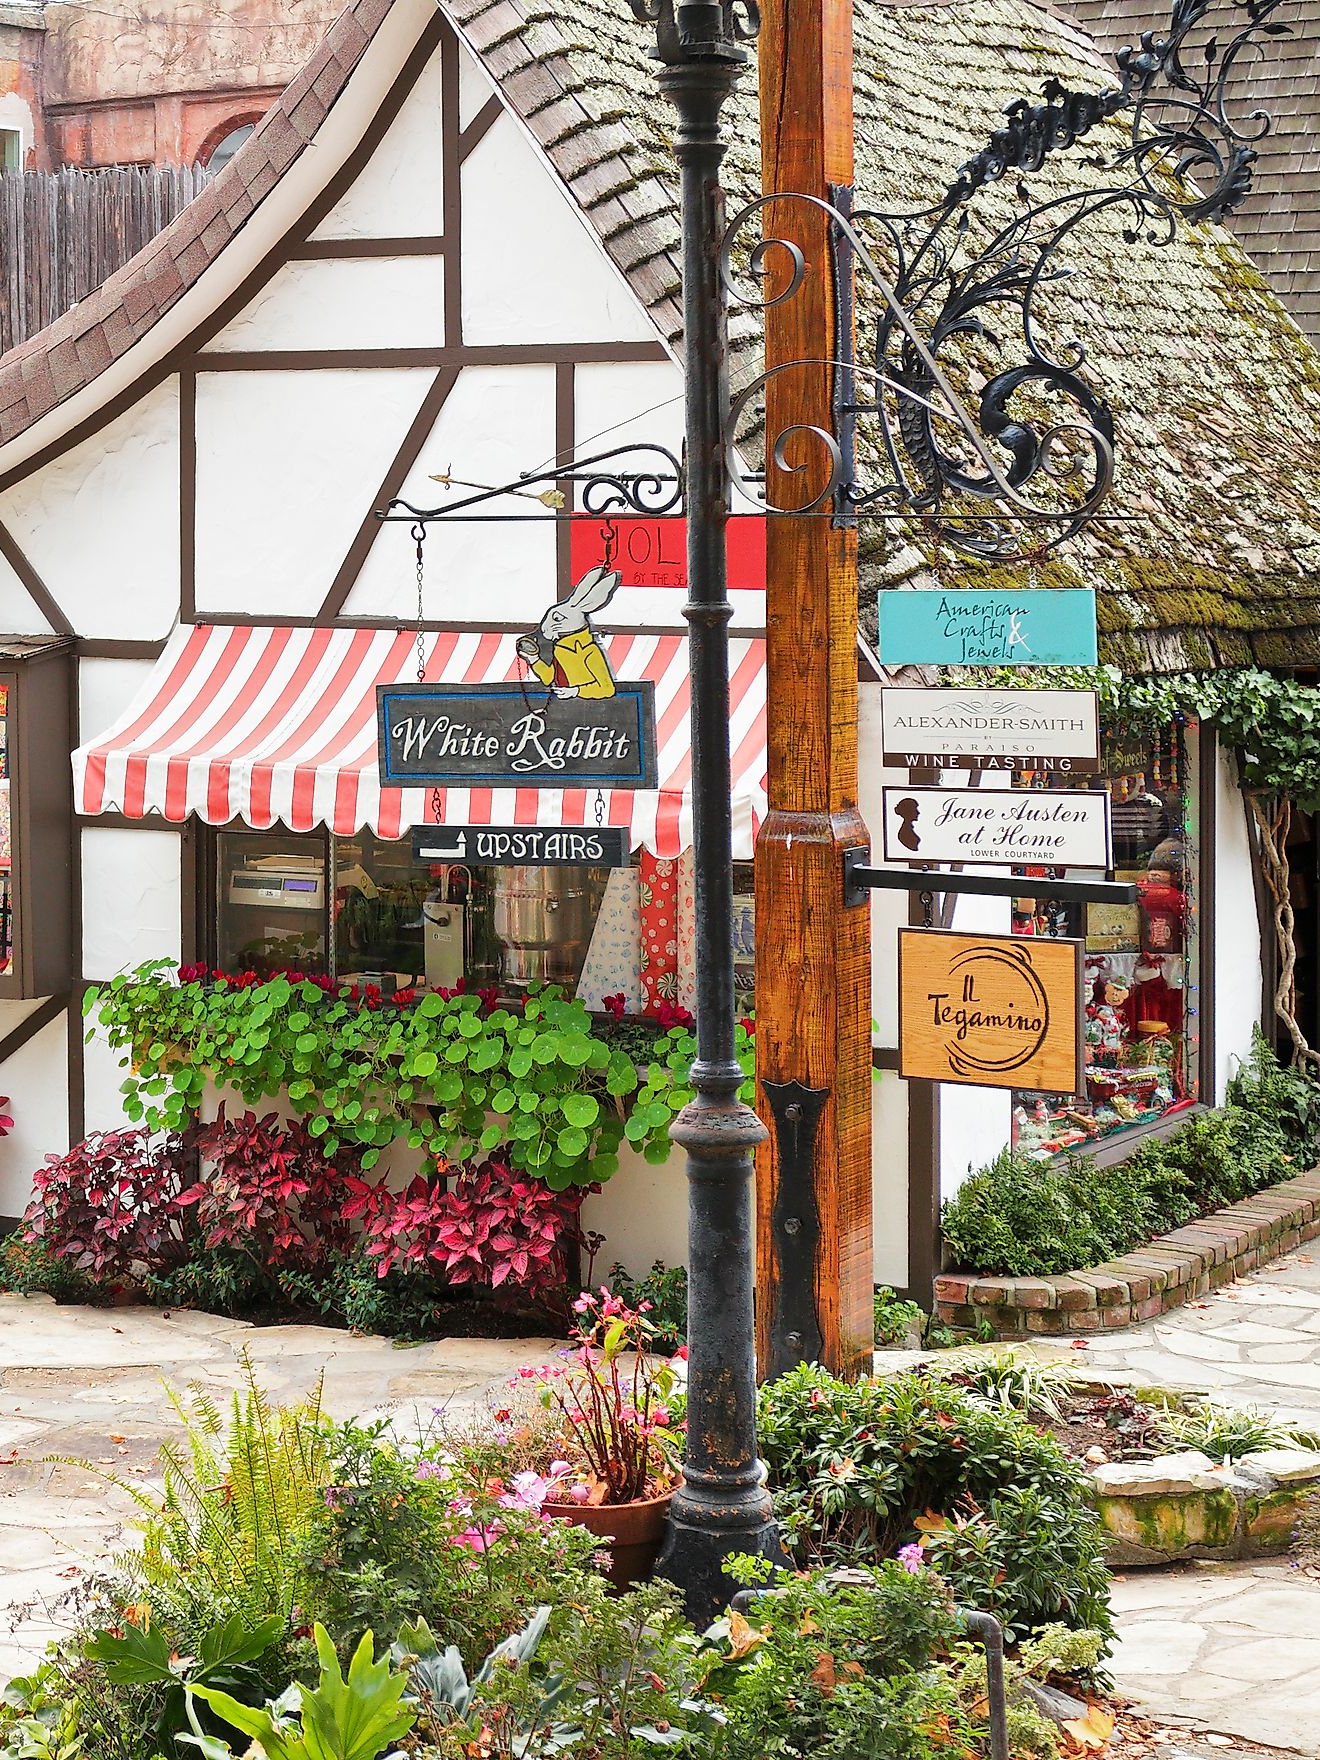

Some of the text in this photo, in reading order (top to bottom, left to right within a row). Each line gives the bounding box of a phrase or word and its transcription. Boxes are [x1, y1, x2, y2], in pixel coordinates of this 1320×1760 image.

[633, 572, 688, 586] BY THE SE
[936, 596, 1030, 620] American
[944, 615, 1005, 647] Crafts
[958, 636, 1015, 663] Jewels
[893, 716, 1084, 731] ALEXANDER-SMITH
[391, 708, 631, 772] White Rabbit
[942, 743, 1035, 753] PARAISO
[905, 754, 1073, 771] WINE TASTING
[934, 797, 1090, 827] Jane Austen
[476, 832, 604, 860] UPSTAIRS
[958, 824, 1067, 848] at Home
[970, 849, 1055, 860] LOWER COURTYARD
[928, 993, 1042, 1041] Tegamino
